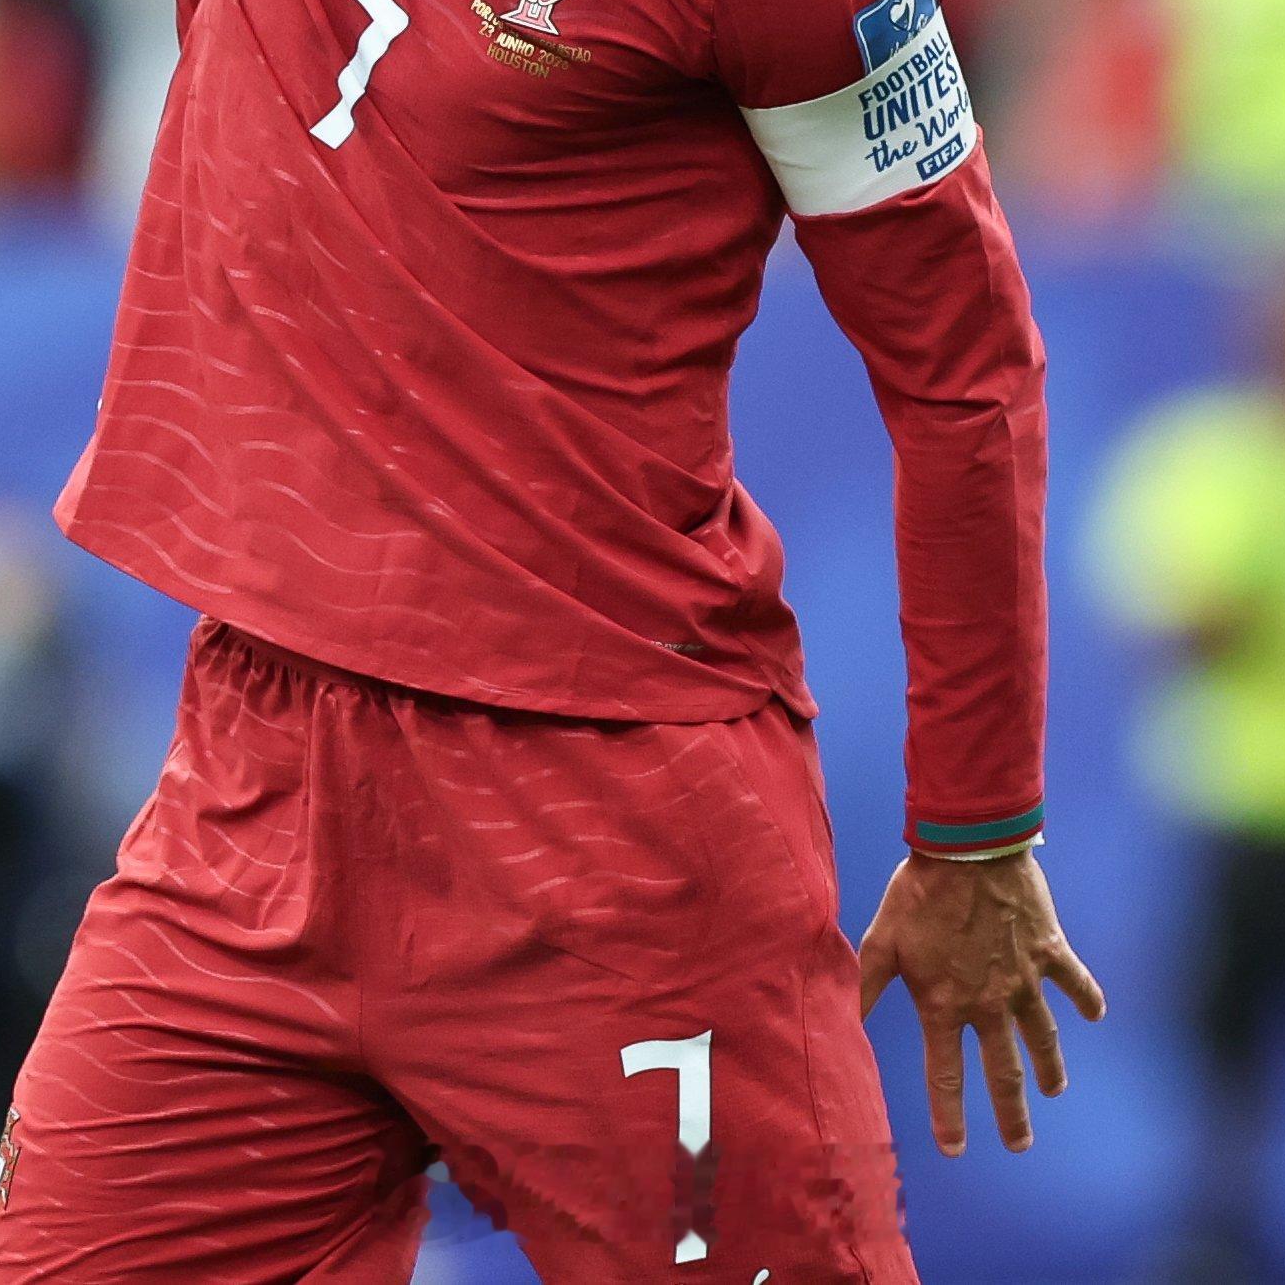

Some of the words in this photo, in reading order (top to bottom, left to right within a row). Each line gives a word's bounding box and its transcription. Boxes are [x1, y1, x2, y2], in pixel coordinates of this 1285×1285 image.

[478, 20, 496, 39] 23
[493, 32, 535, 58] JUNHO
[486, 42, 550, 79] HOUSTON
[858, 31, 949, 111] FOOTBALL
[863, 51, 958, 141] UNITES
[865, 140, 918, 173] the
[919, 139, 963, 178] FIFA
